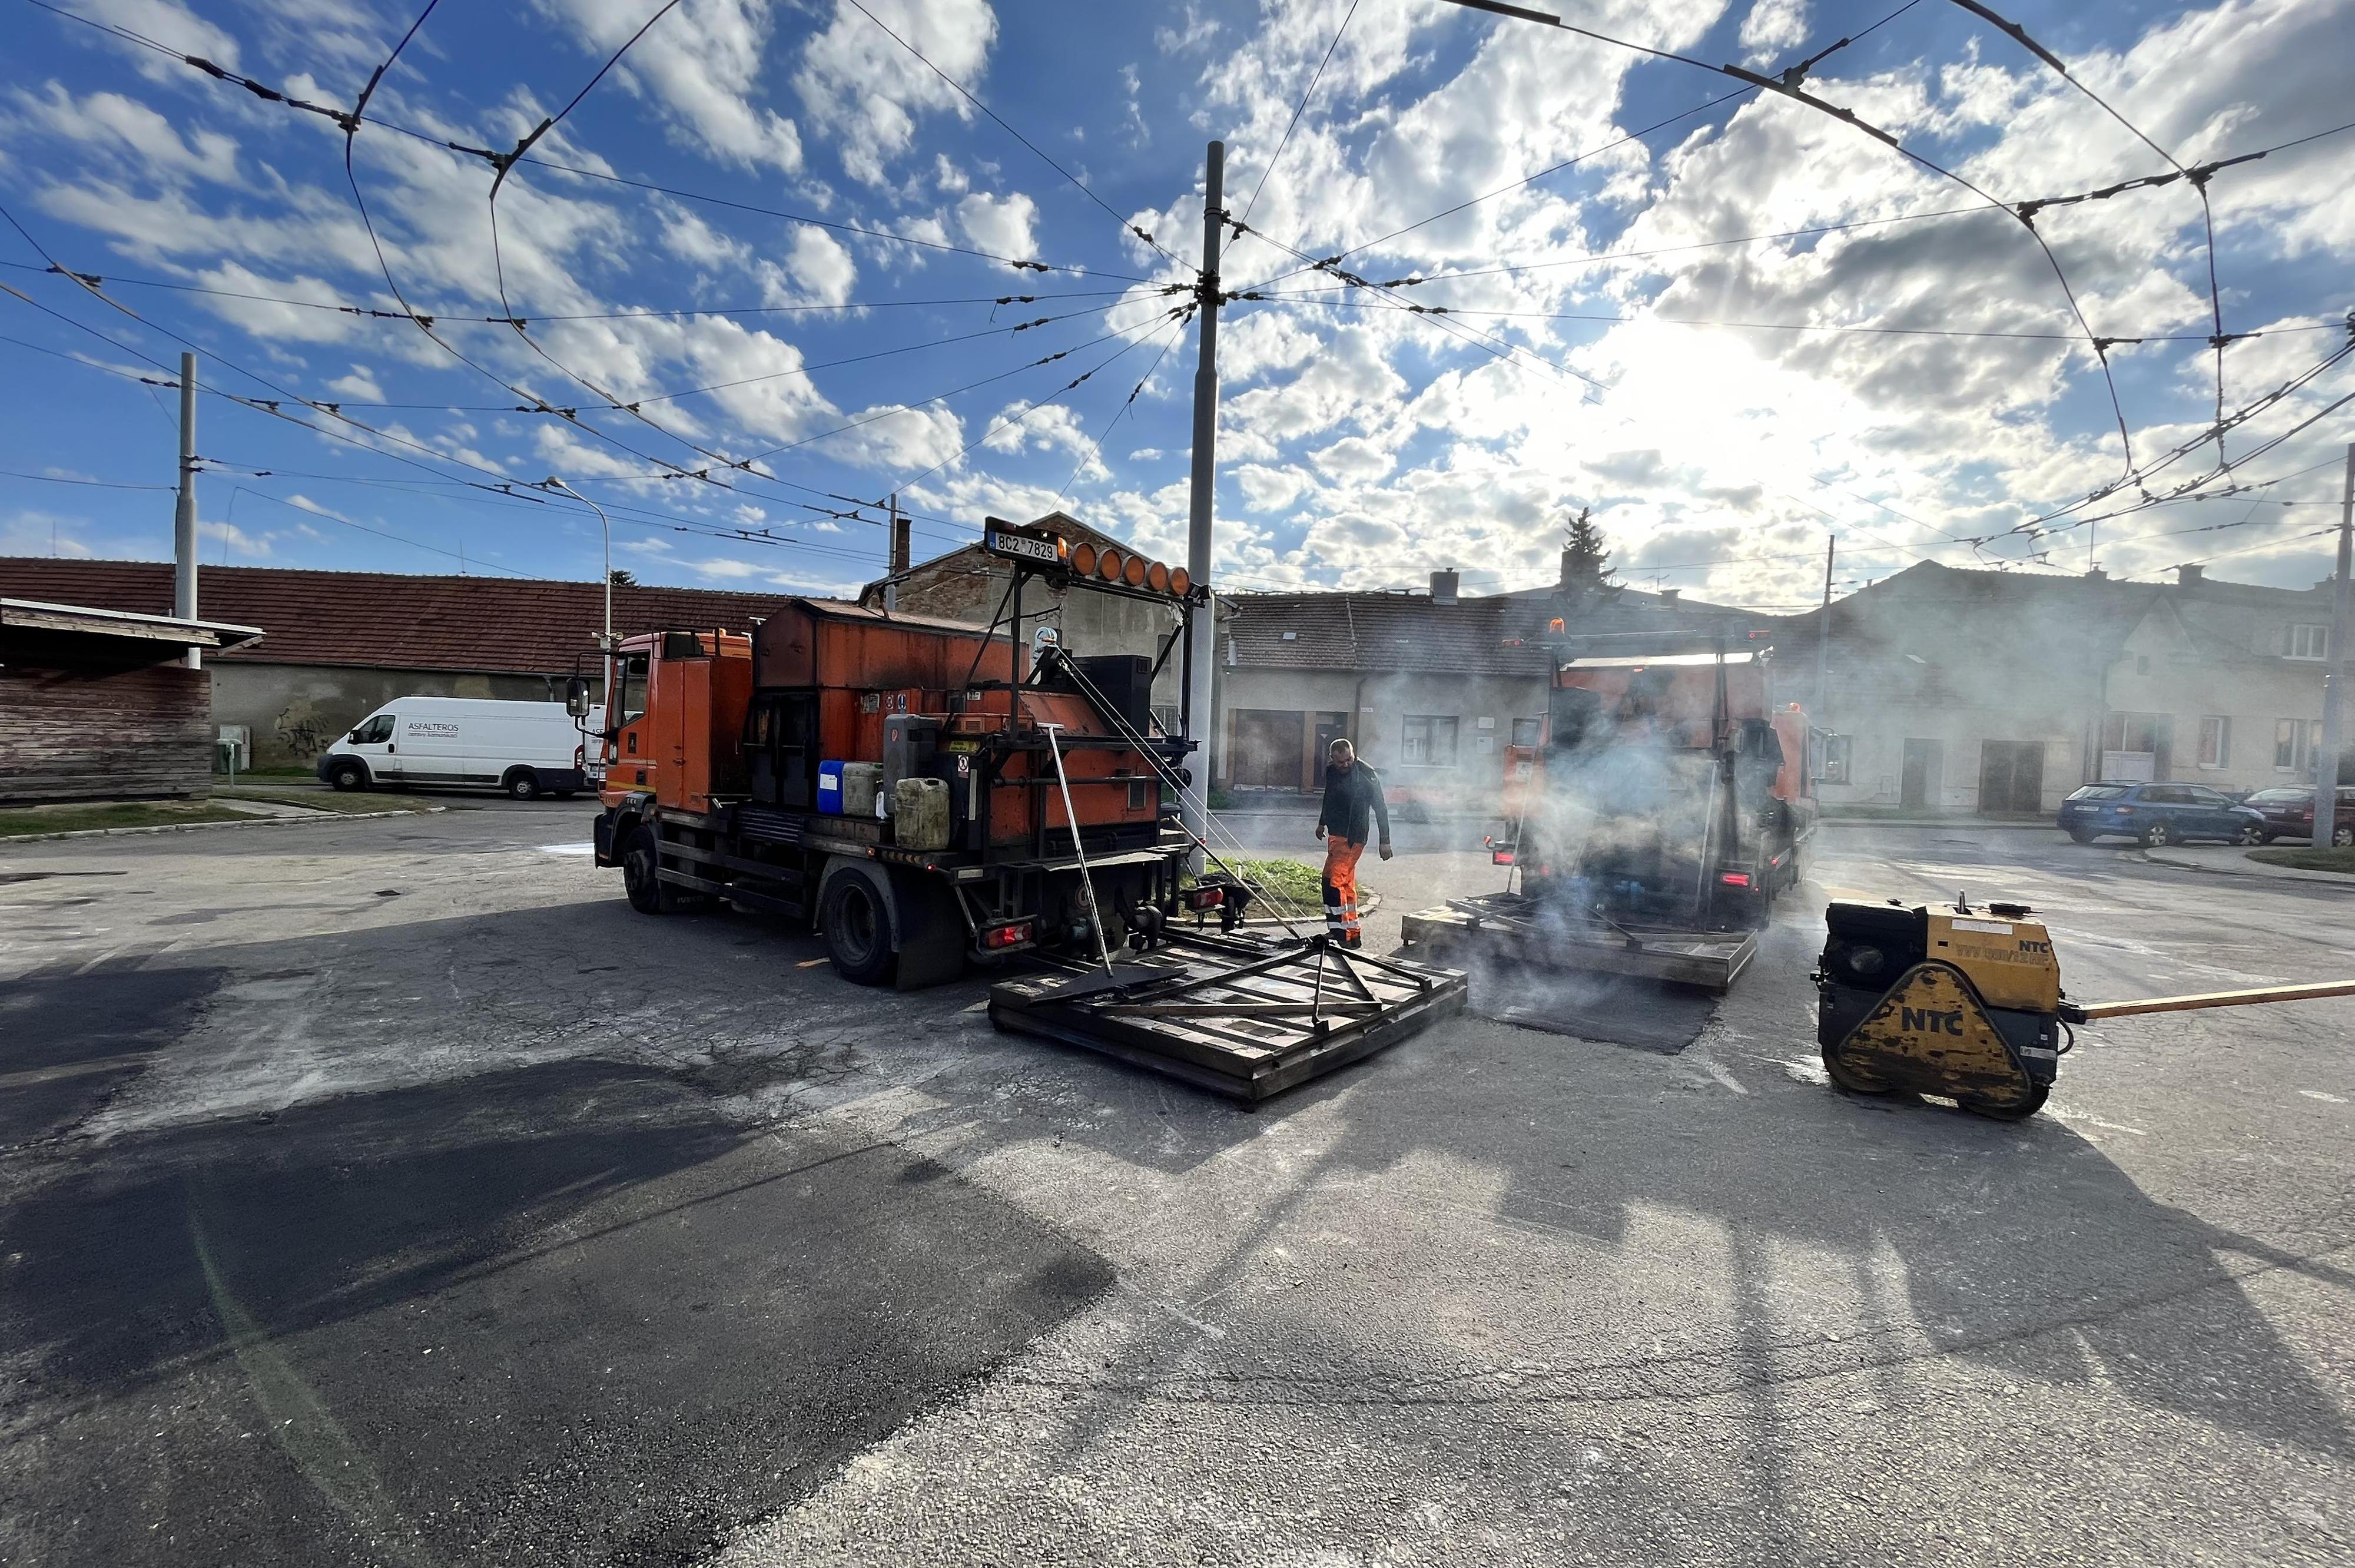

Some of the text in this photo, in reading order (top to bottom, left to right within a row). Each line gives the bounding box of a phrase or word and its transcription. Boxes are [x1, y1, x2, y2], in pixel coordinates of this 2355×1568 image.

[999, 535, 1053, 559] 8C2 7829
[408, 722, 459, 731] ASFALTEROS
[677, 895, 704, 904] IVECO
[2019, 940, 2049, 953] NTC
[1902, 1006, 1963, 1036] NTC
